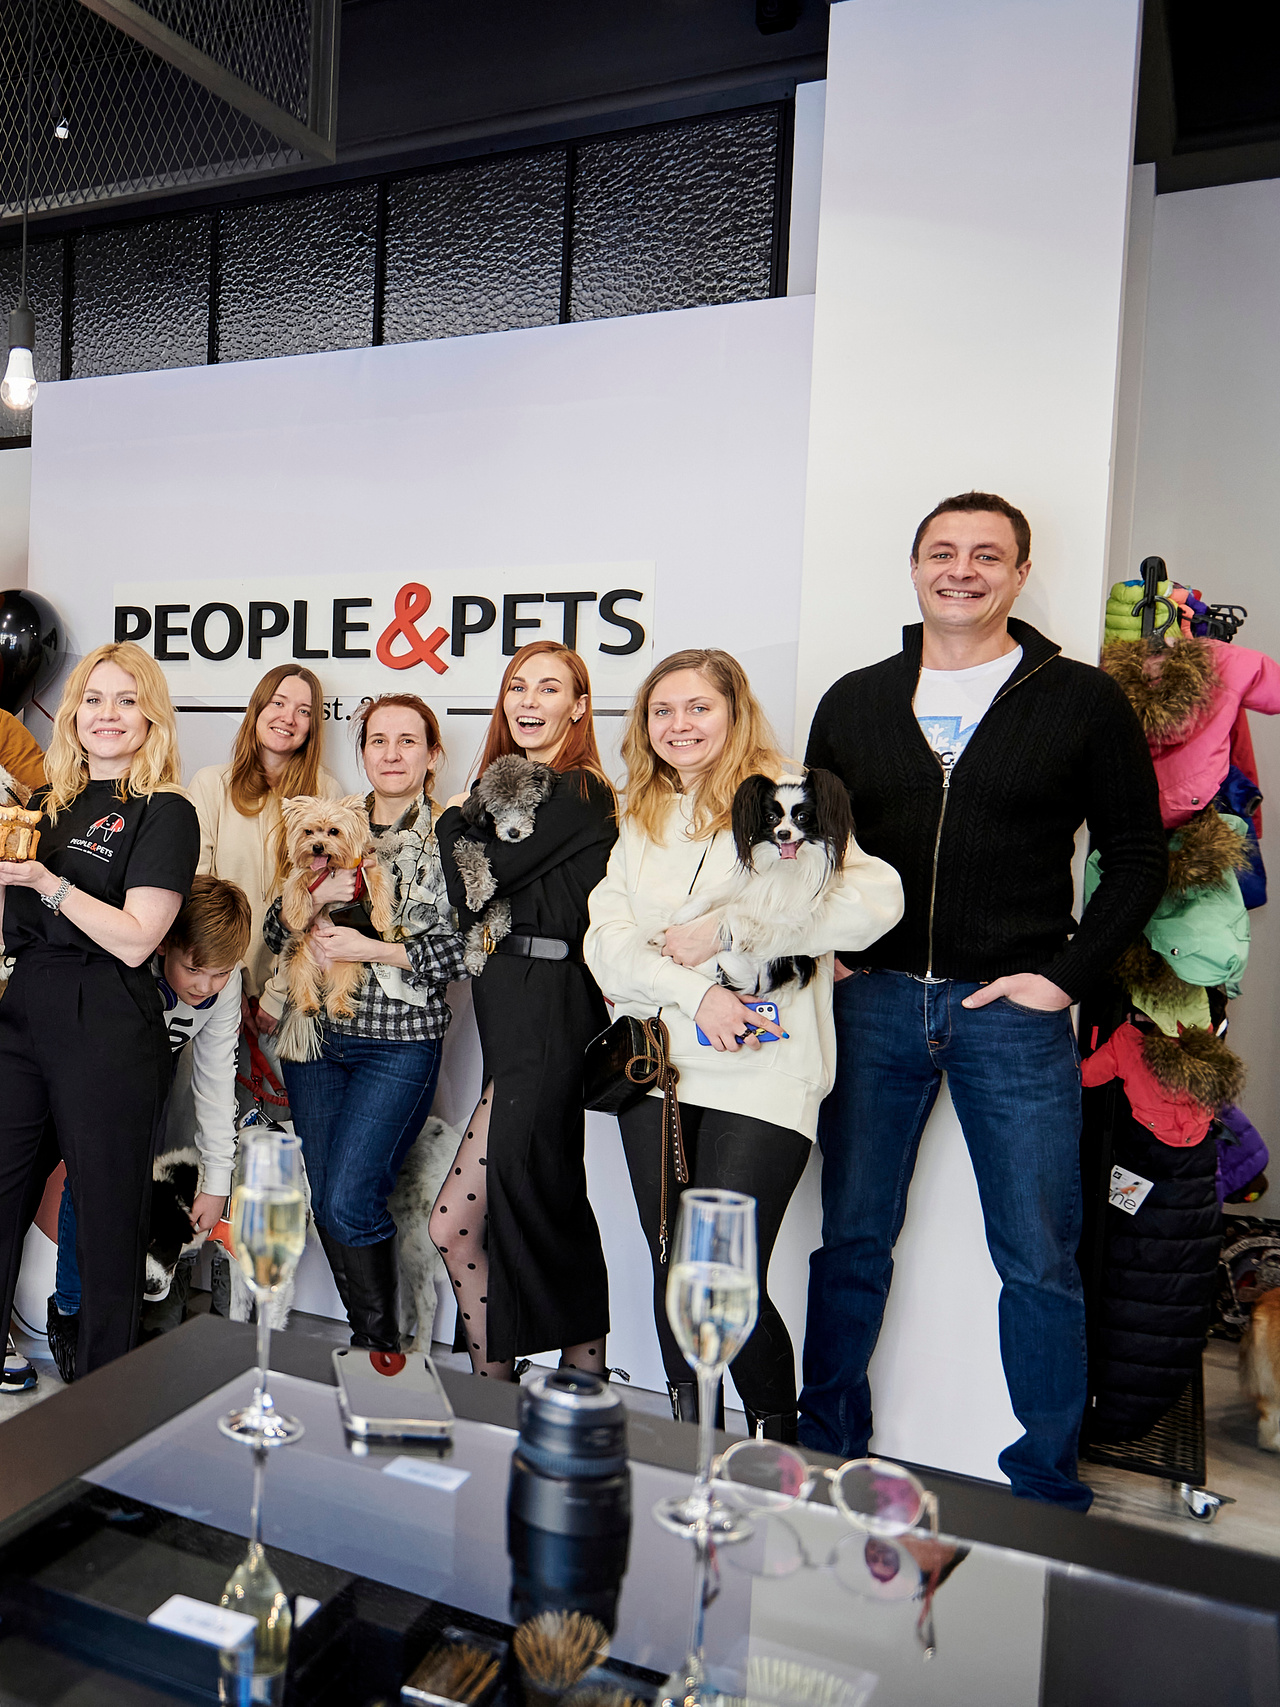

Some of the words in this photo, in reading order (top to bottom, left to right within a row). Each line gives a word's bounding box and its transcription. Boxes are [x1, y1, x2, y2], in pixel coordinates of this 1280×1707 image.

[114, 582, 646, 675] PEOPLE&PETS
[322, 697, 352, 721] st.
[70, 838, 114, 857] PEOPLE&PETS
